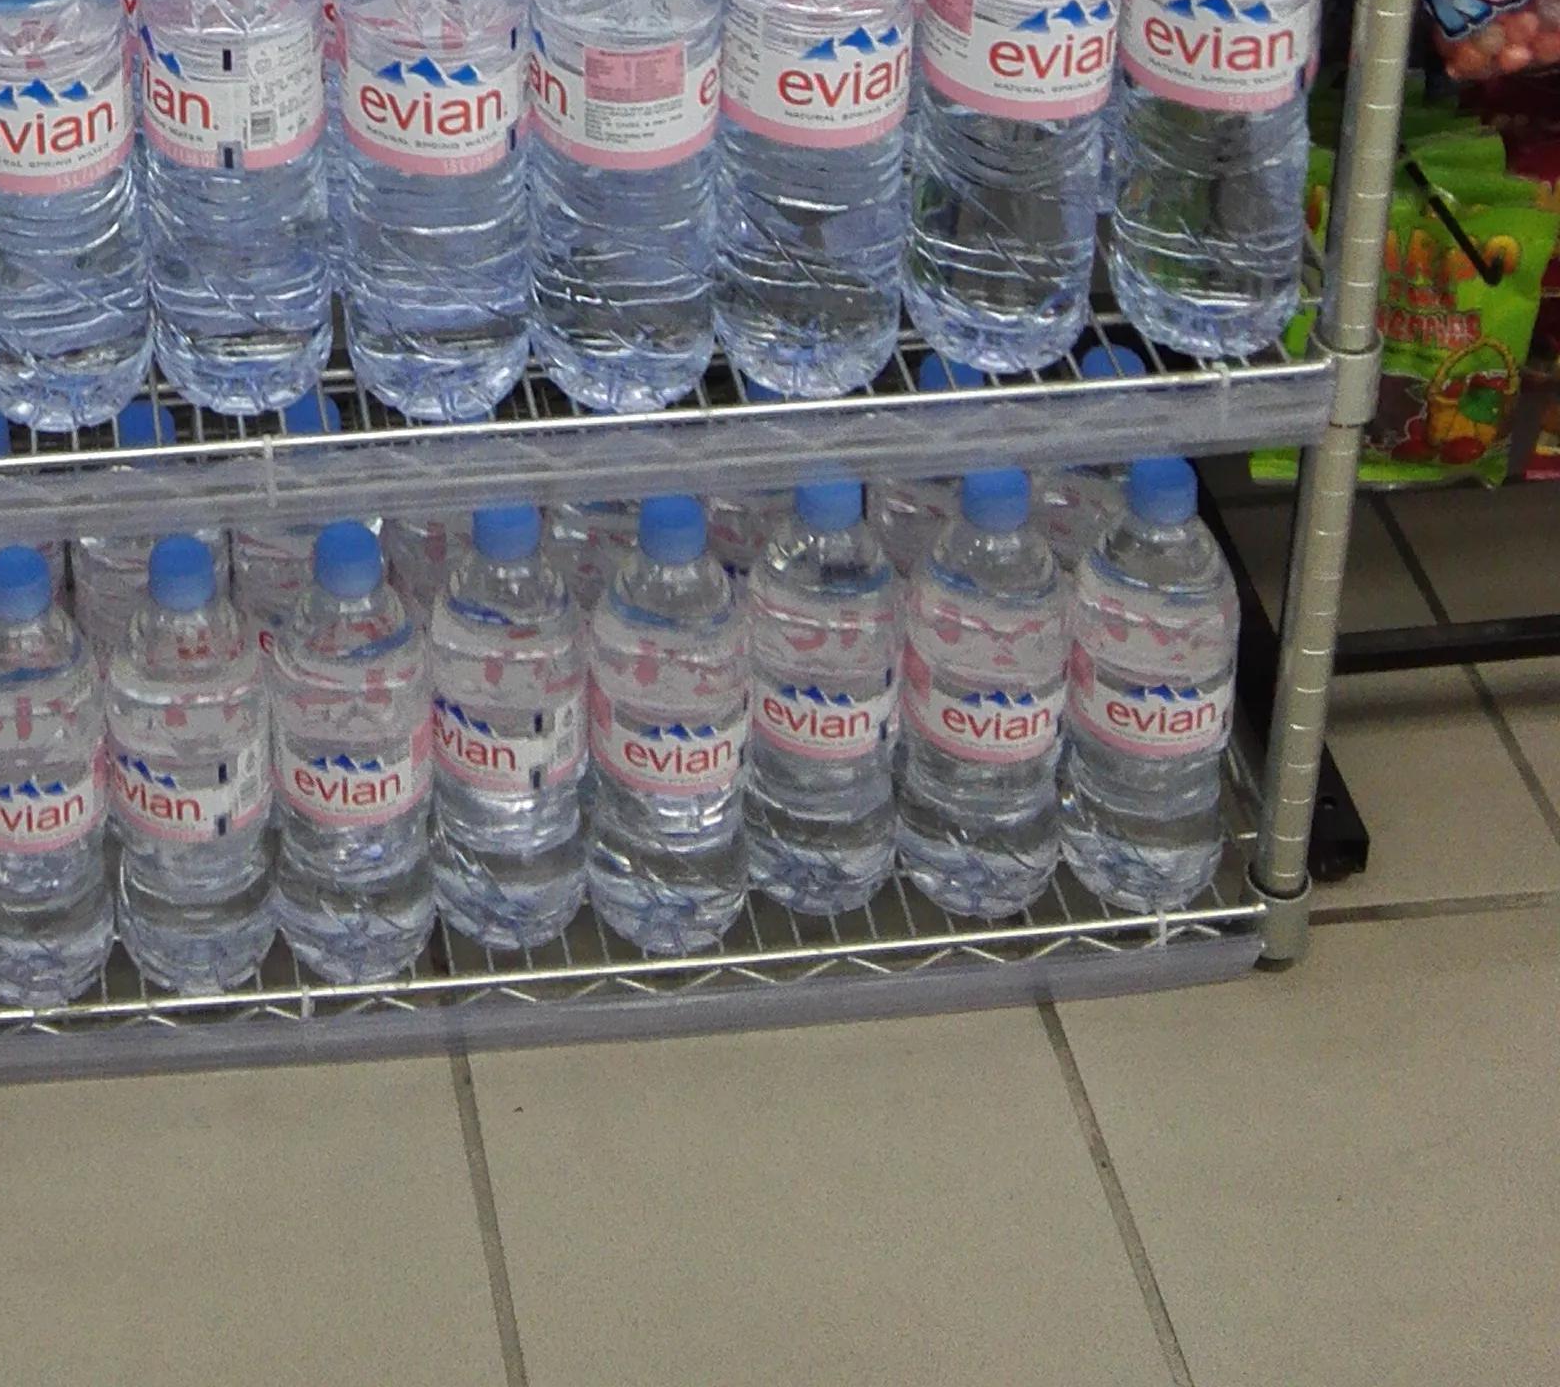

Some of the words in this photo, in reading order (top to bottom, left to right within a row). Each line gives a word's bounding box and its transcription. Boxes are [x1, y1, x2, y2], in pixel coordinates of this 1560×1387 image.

[1145, 17, 1295, 71] evian
[143, 57, 211, 129] ian
[360, 84, 503, 135] evian
[763, 695, 871, 739] evian
[942, 704, 1051, 742] evian
[1106, 701, 1216, 735] evian
[624, 737, 733, 777] evian
[295, 767, 401, 806] evian
